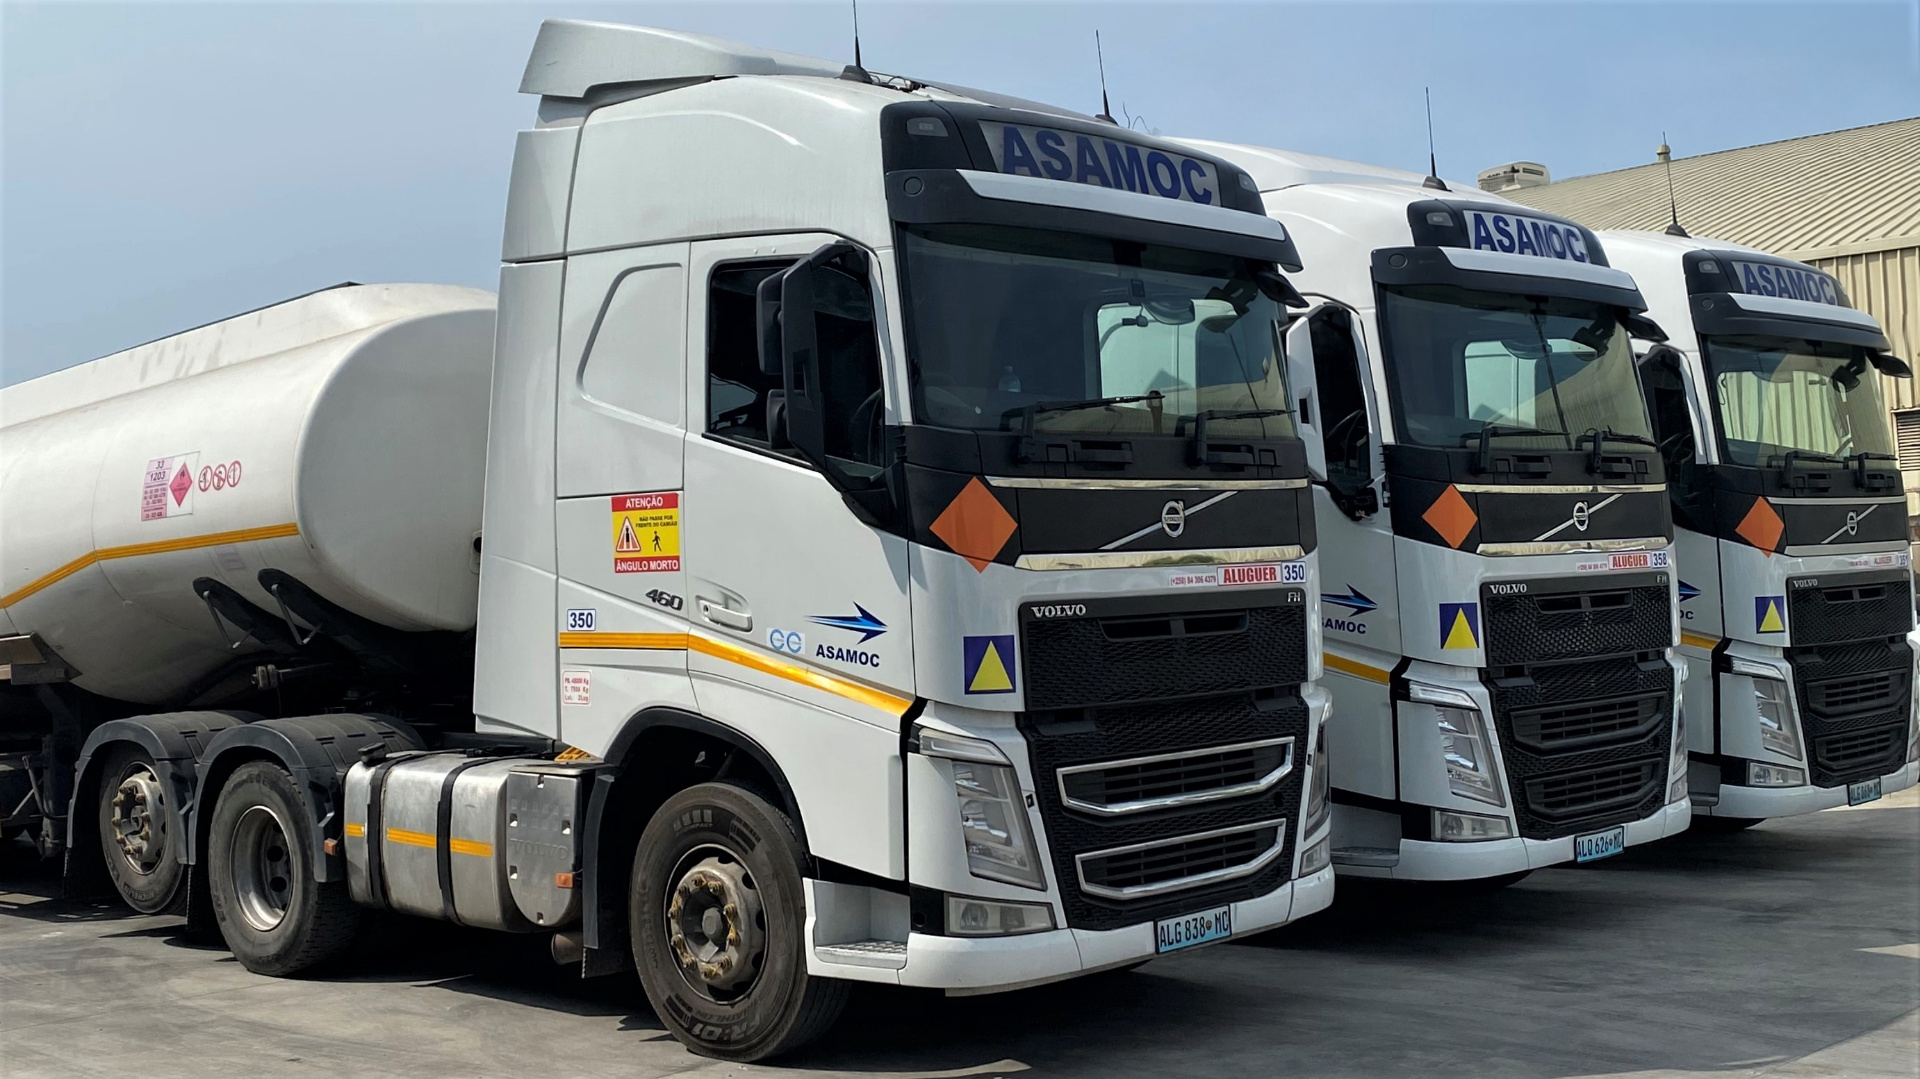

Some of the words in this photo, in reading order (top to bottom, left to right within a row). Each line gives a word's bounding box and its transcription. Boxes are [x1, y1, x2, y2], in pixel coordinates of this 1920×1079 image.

[1003, 126, 1212, 205] ASAMOC
[1473, 213, 1587, 263] ASAMOC
[1743, 263, 1835, 306] ASAMOC
[150, 471, 166, 482] 1203
[625, 495, 663, 509] ATENÇÃO
[616, 559, 648, 572] ÂNGULO
[650, 560, 679, 571] MORTO
[1612, 554, 1648, 568] ALUGUER
[1223, 566, 1277, 583] ALUGUER
[1284, 564, 1304, 581] 350
[1656, 574, 1667, 583] FH
[1489, 583, 1527, 595] VOLVO
[1793, 579, 1818, 588] VOLVO
[645, 589, 683, 611] 460
[1287, 591, 1300, 603] FH
[1031, 604, 1087, 618] VOLVO
[570, 612, 593, 628] 350
[1321, 617, 1366, 634] AMOC
[816, 644, 880, 667] ASAMOC
[1595, 834, 1609, 854] 626
[1160, 921, 1182, 947] ALG
[1185, 916, 1206, 941] 838
[1214, 910, 1229, 934] MC
